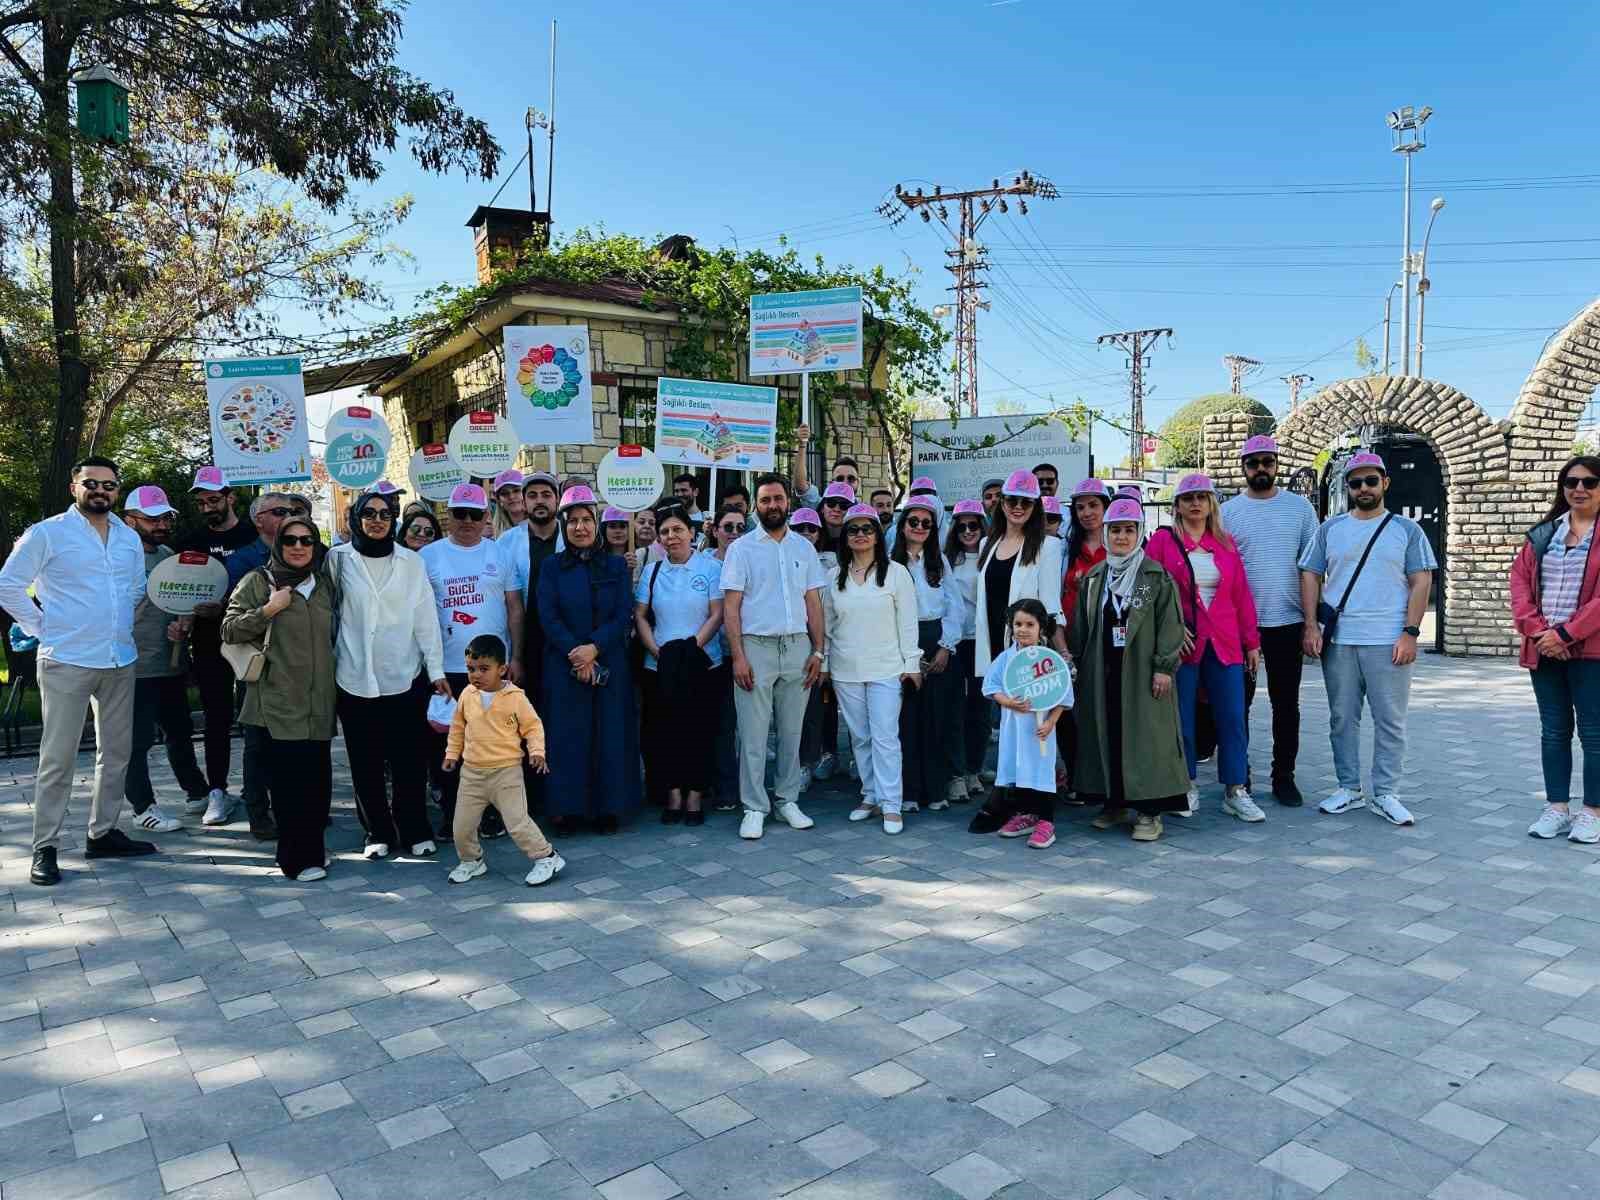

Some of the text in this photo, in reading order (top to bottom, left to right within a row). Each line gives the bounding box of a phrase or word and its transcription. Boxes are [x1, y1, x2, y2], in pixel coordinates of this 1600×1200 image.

[352, 443, 374, 459] 10
[918, 451, 939, 462] PARK
[941, 450, 952, 461] VE
[954, 448, 999, 462] BAHÇELER
[447, 583, 475, 596] GÜCÜ
[1032, 657, 1053, 678] 10
